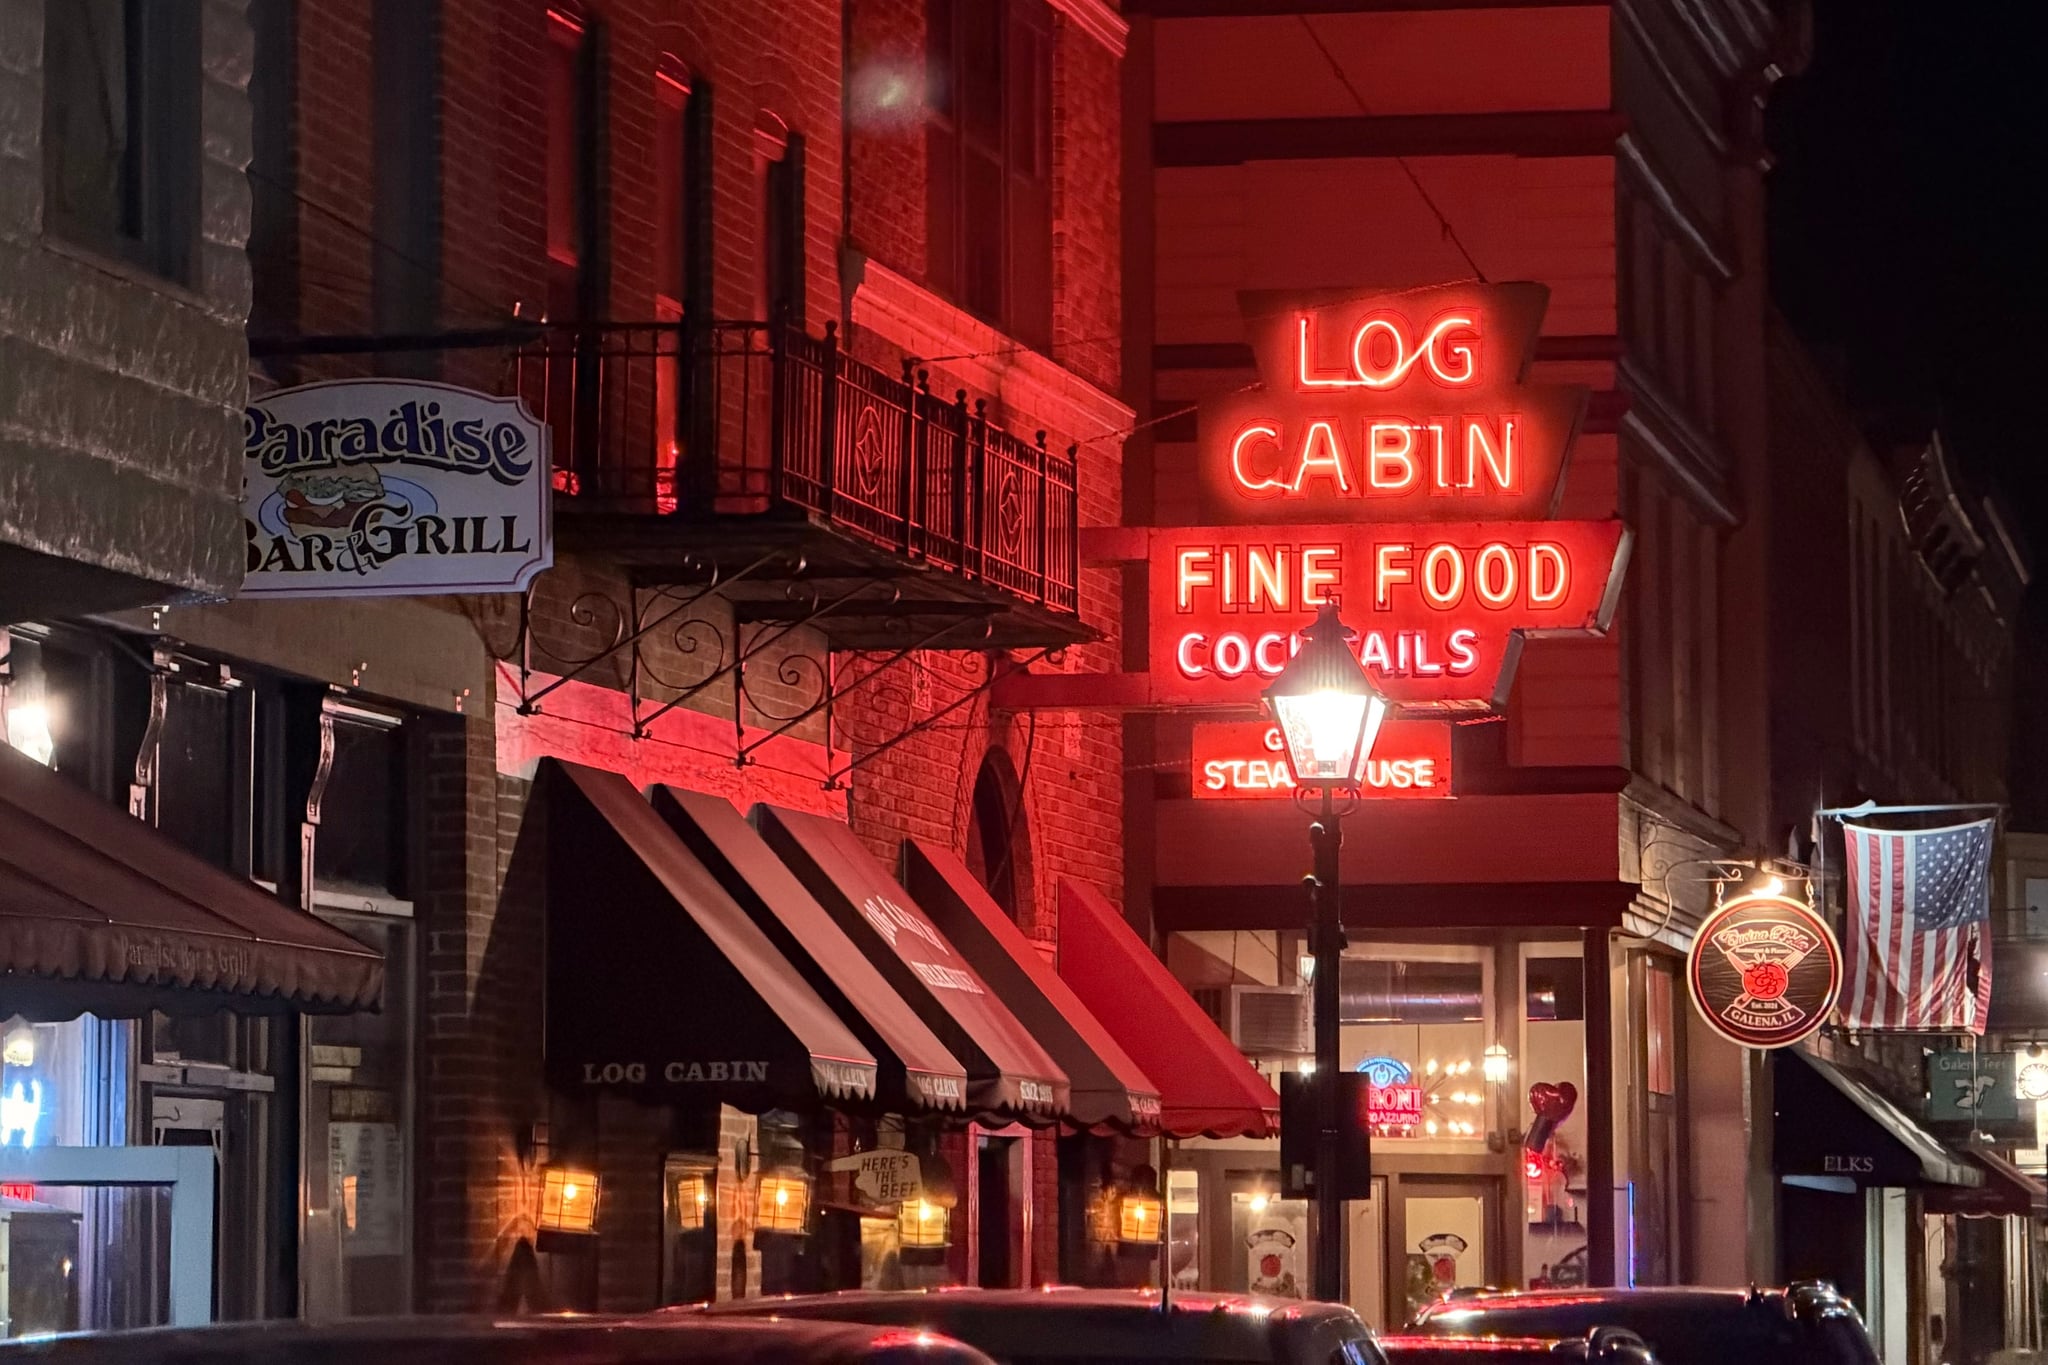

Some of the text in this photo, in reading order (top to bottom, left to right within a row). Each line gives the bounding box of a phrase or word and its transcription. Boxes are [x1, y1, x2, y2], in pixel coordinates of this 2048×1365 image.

[1294, 306, 1483, 393] LOG
[1229, 414, 1524, 499] CABIN
[352, 503, 531, 563] GRILL
[1176, 541, 1571, 614] FINE FOOD
[1176, 629, 1482, 680] COCAILS
[1203, 757, 1436, 791] STEAUSE
[1730, 1009, 1796, 1027] GALENA, IL
[583, 1061, 770, 1084] LOG CABIN
[1369, 1087, 1422, 1111] RONI
[861, 1154, 910, 1172] HERE'S
[875, 1170, 898, 1184] THE
[1824, 1155, 1874, 1173] ELKS
